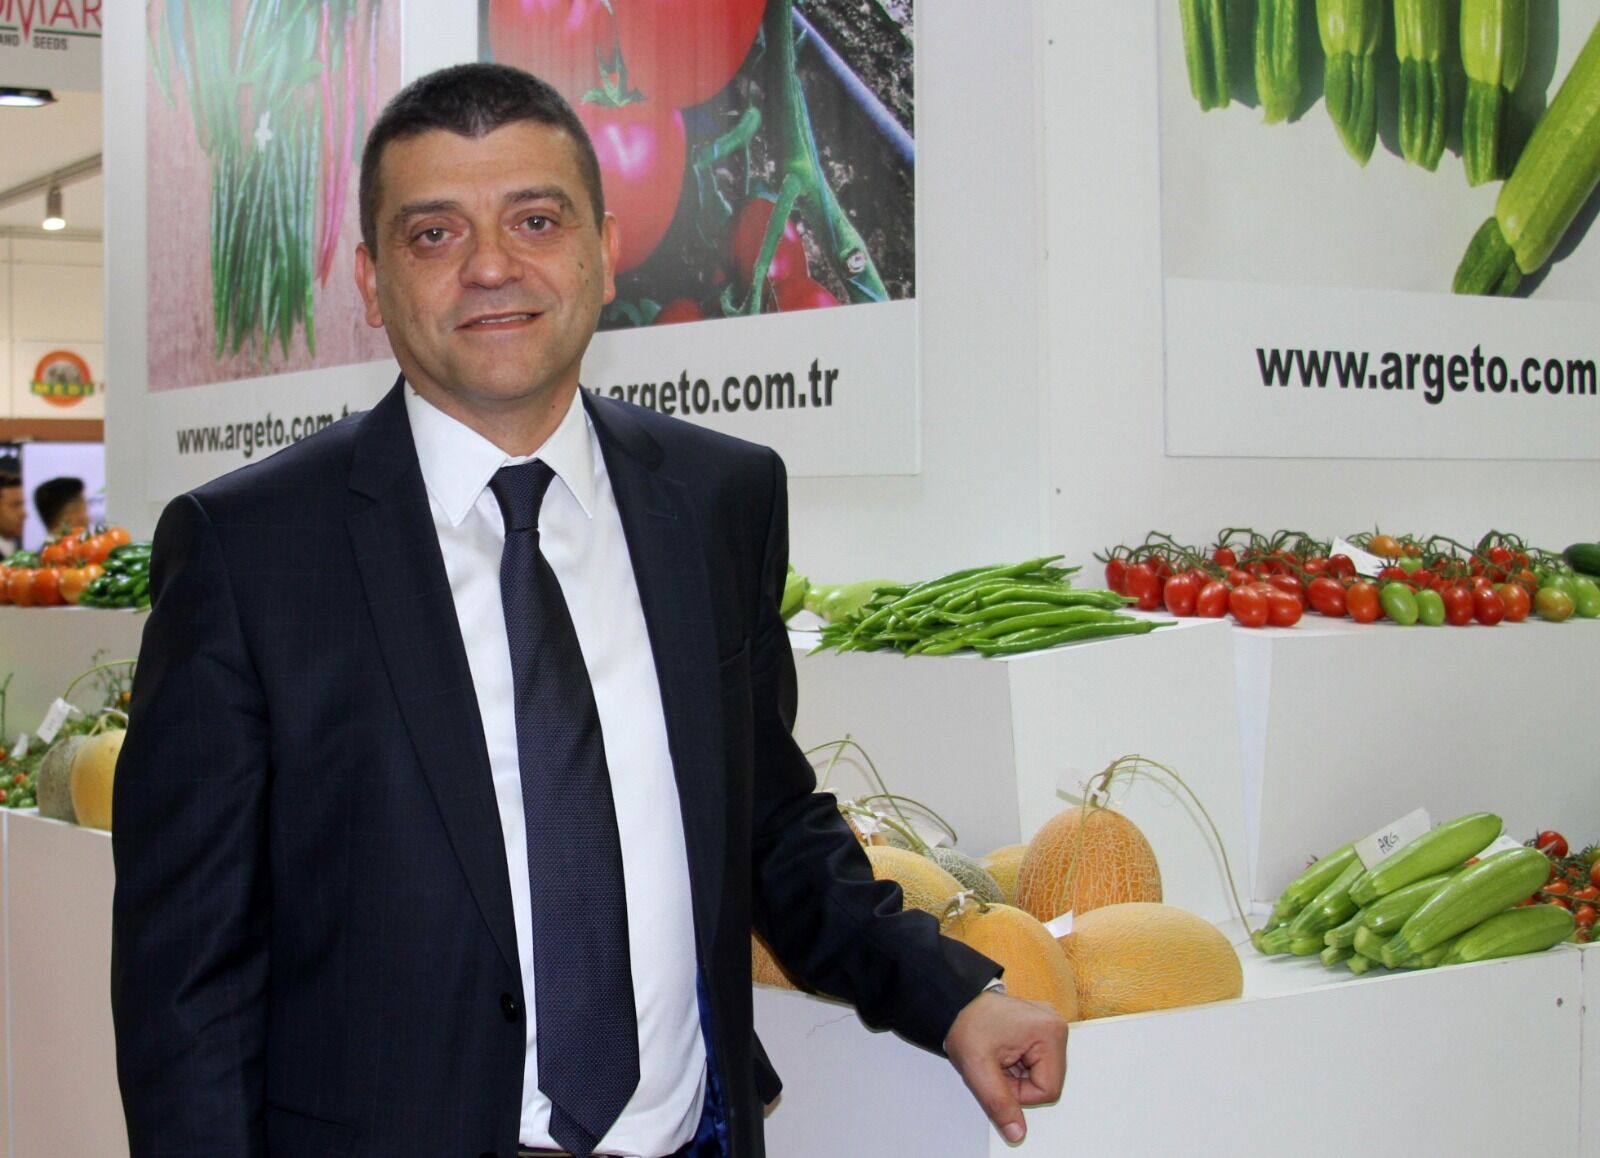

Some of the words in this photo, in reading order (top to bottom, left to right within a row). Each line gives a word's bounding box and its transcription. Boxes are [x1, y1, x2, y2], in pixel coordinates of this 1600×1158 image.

[33, 36, 68, 50] SEEDS
[586, 357, 839, 416] rgeto.com.tr
[1256, 344, 1597, 405] www.argeto.com
[177, 403, 357, 458] www.argeto.com
